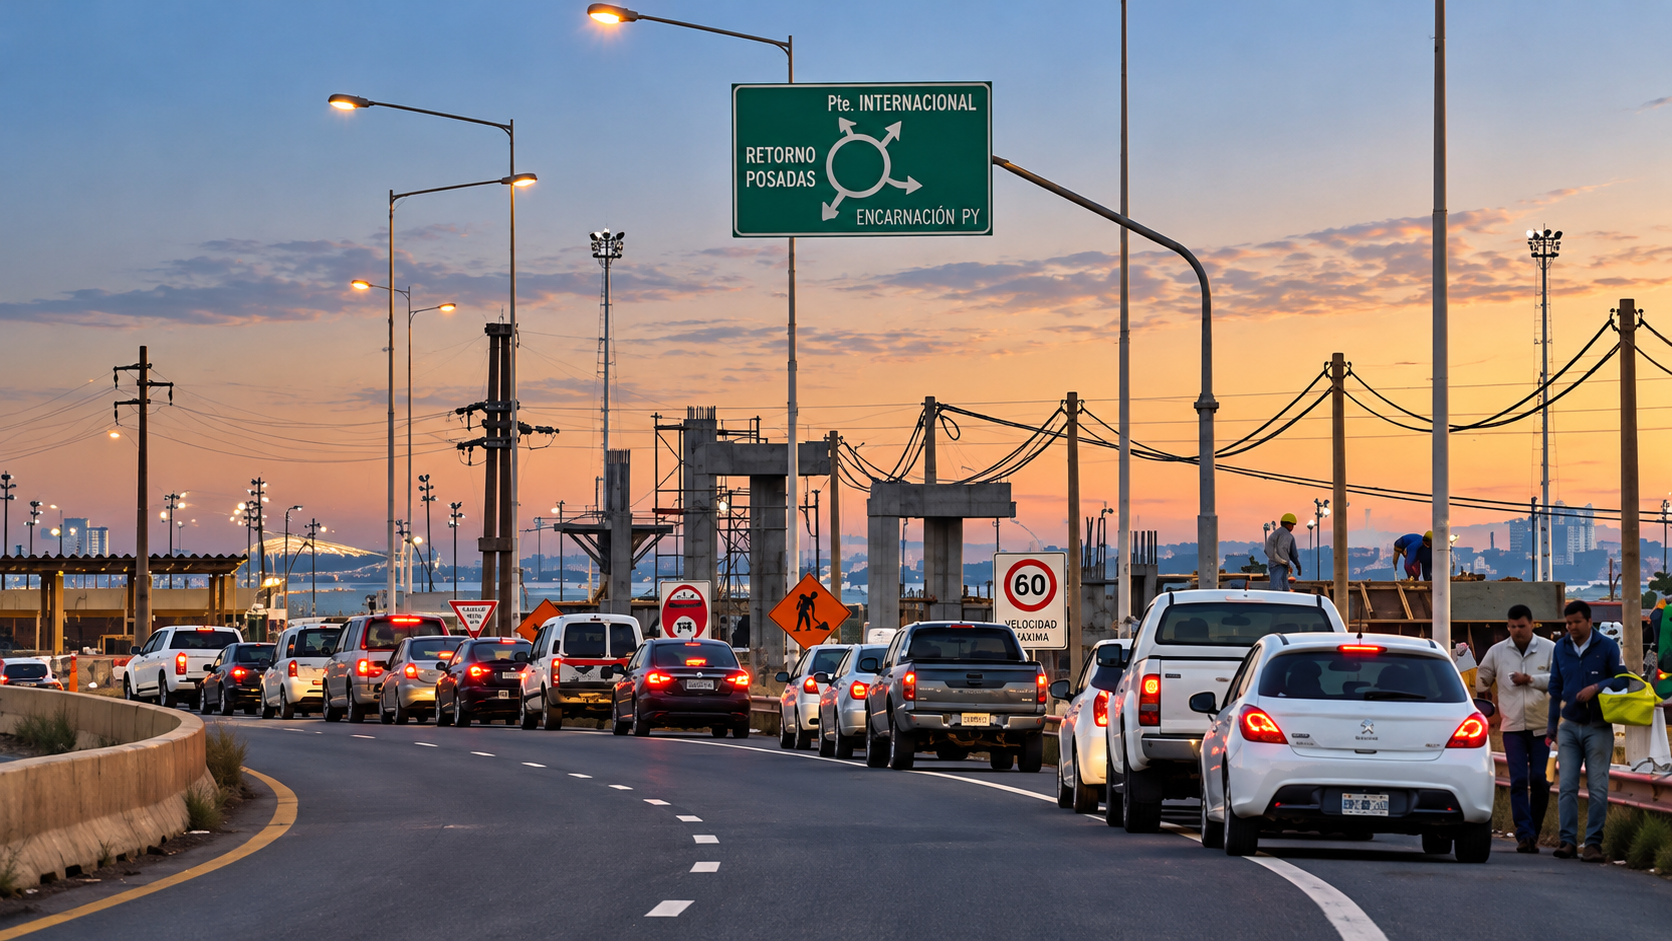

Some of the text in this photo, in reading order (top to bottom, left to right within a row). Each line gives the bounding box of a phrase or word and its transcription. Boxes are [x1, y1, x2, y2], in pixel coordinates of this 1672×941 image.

[828, 94, 977, 112] Pte. INTERNACIONAL
[746, 146, 816, 164] RETORNO
[746, 170, 816, 188] POSADAS
[856, 206, 980, 225] ENCARNACIÓN PY
[1014, 574, 1046, 596] 60
[1004, 619, 1058, 629] VELOCIDAD
[1017, 632, 1050, 642] AXIMA
